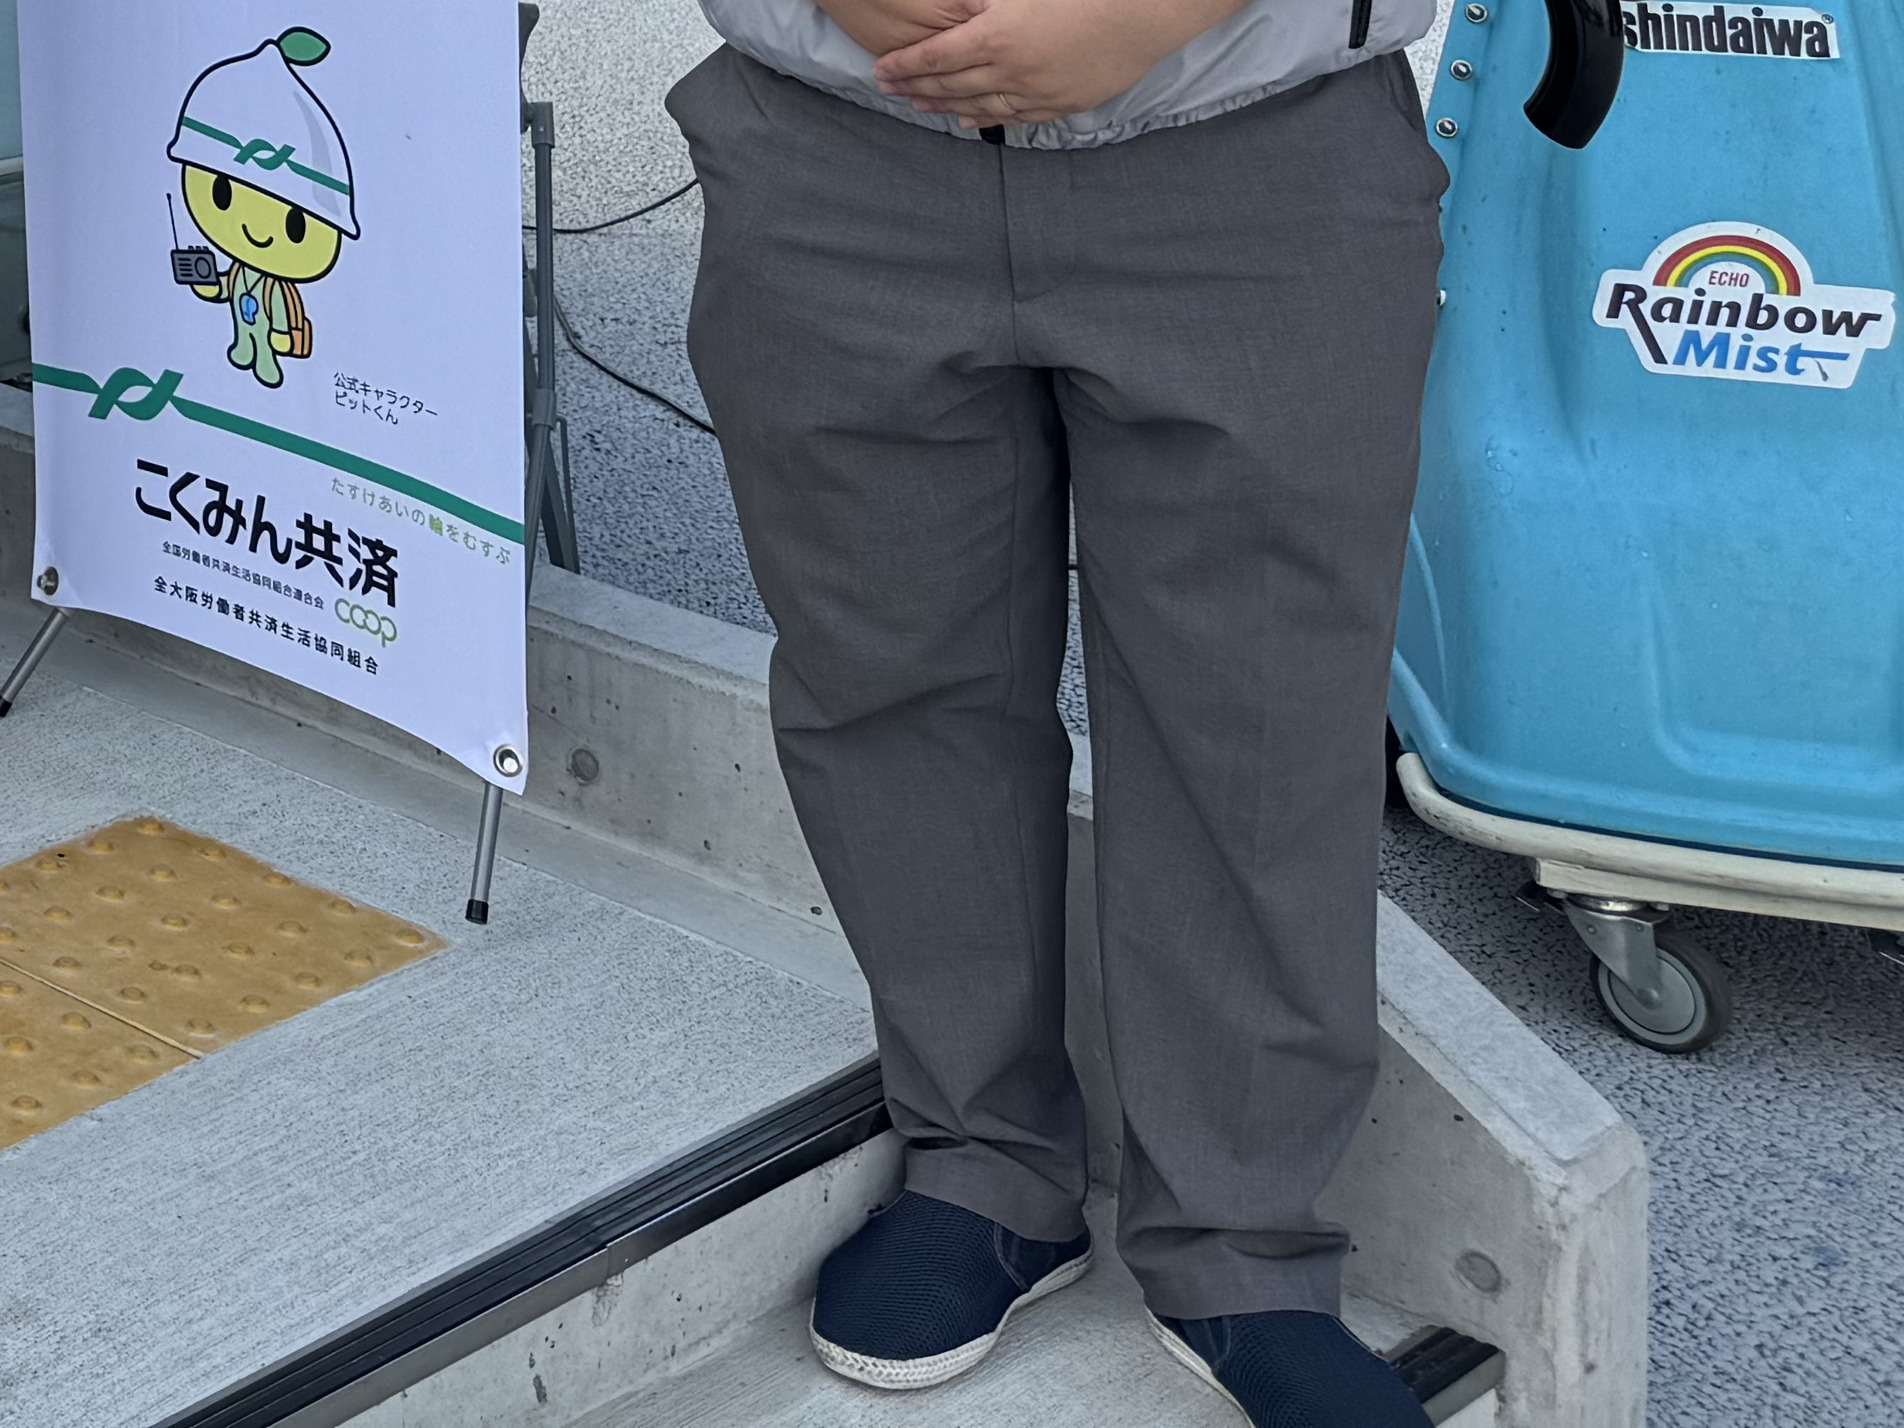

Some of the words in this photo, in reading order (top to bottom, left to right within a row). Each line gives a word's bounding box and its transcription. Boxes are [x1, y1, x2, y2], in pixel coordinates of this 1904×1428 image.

[1622, 2, 1831, 58] shindaiwa
[1708, 270, 1750, 289] ECHO
[1605, 282, 1882, 365] Rainbow
[1672, 329, 1850, 376] Mist
[333, 371, 439, 417] 公式キャラクター
[334, 390, 399, 426] ピットくん
[134, 457, 399, 609] こくみん共済
[331, 477, 511, 565] たすけあいの輪をむすぶ
[153, 575, 379, 676] 全大阪労働者共済生活協同組合
